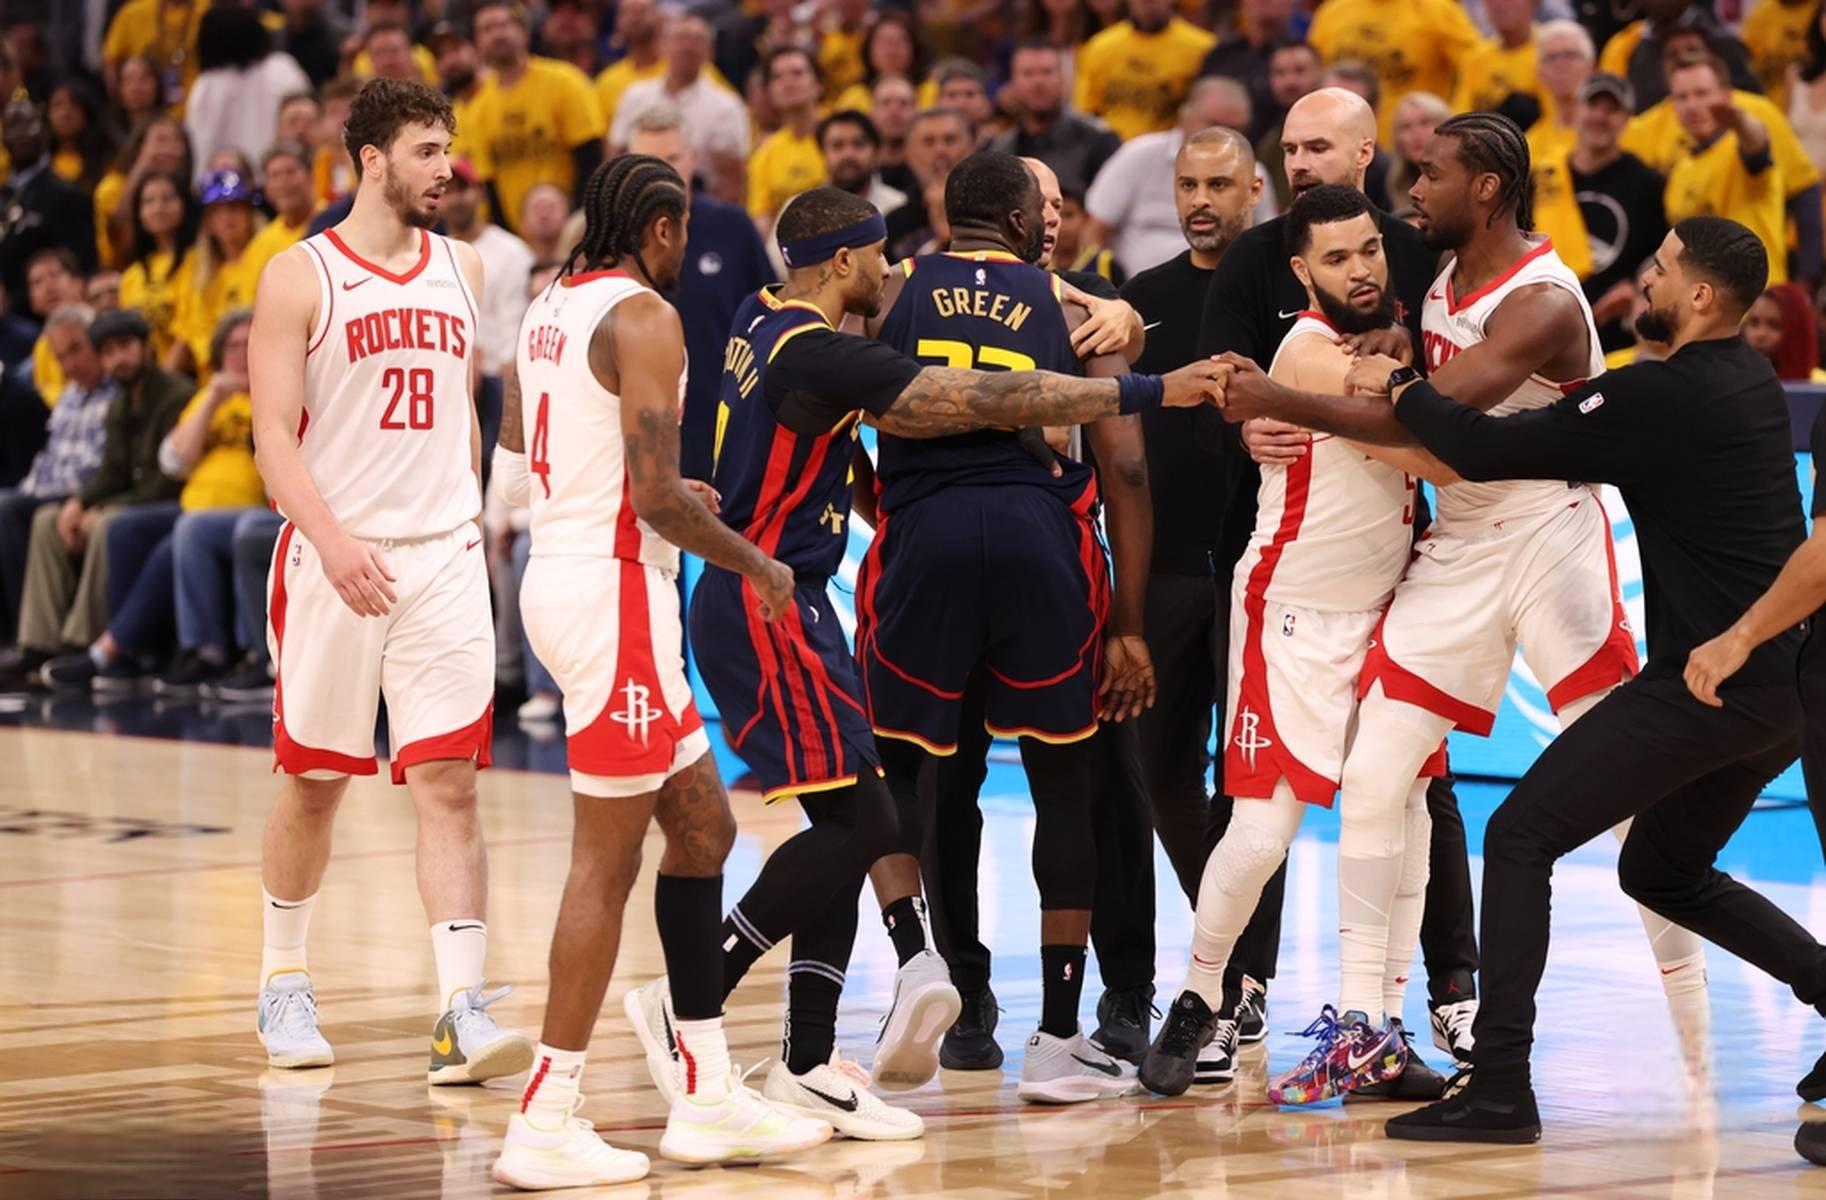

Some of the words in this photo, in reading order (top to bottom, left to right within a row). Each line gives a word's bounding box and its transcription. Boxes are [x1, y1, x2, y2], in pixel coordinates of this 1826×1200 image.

[345, 308, 466, 363] ROCKETS
[931, 287, 1032, 332] GREEN
[528, 325, 568, 367] GREEN
[379, 367, 434, 430] 28
[531, 392, 551, 500] 4
